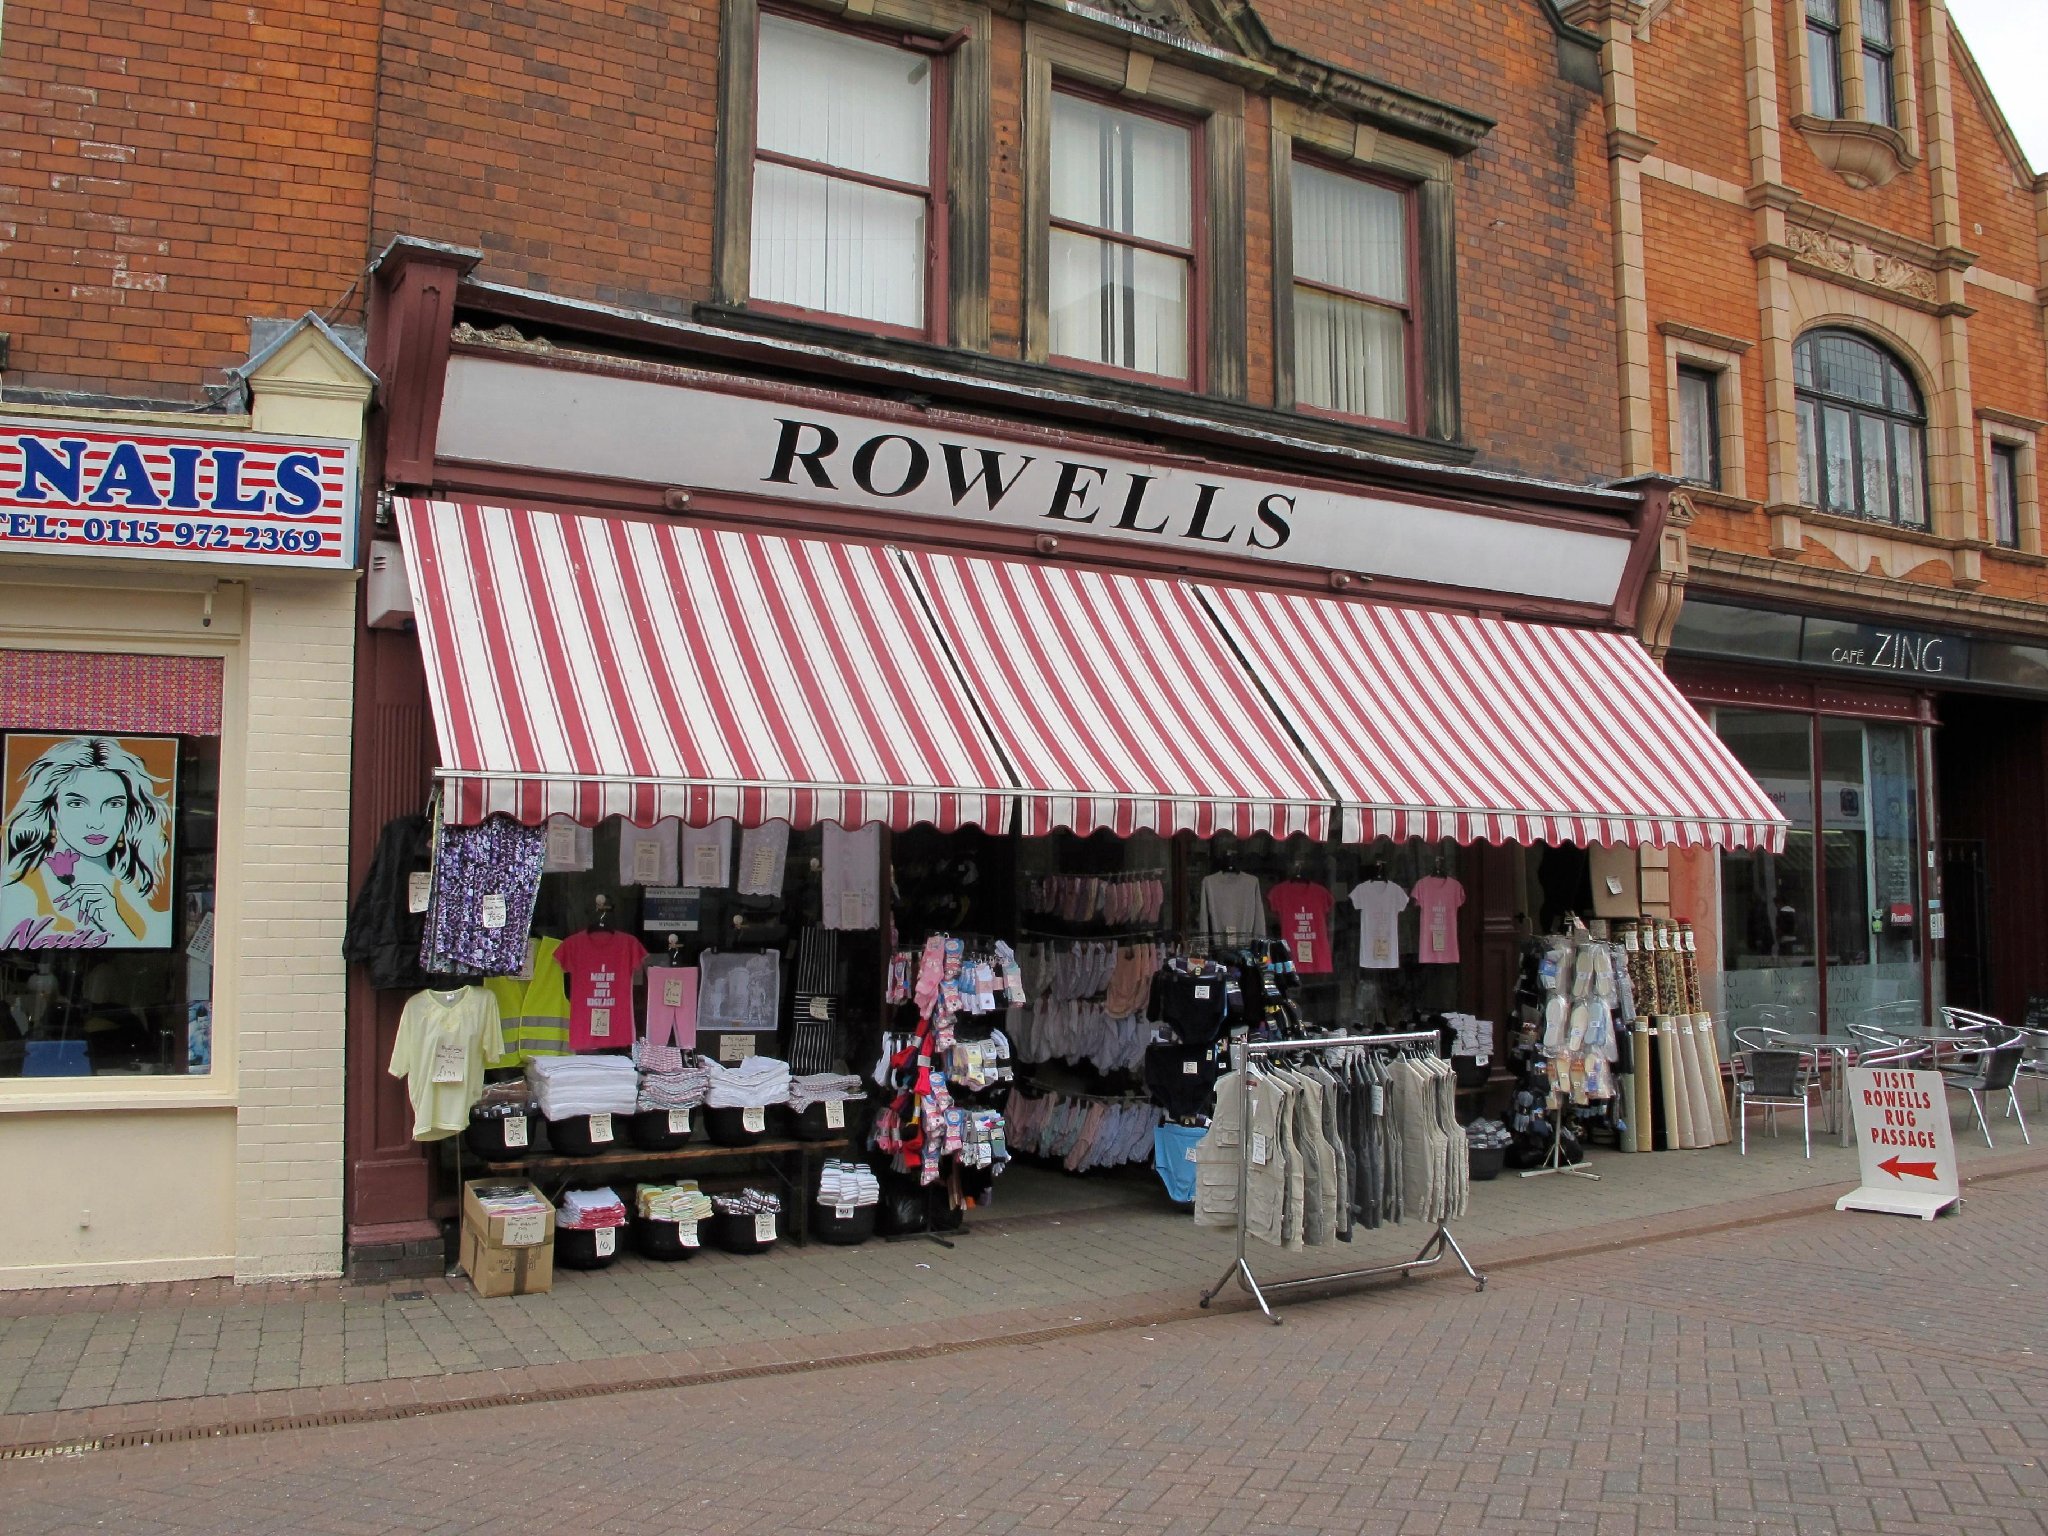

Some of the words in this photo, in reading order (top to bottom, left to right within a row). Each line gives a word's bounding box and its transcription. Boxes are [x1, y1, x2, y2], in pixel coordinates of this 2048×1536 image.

[16, 437, 322, 516] NAILS
[760, 418, 1297, 550] ROWELLS
[84, 518, 160, 545] 0115
[175, 523, 230, 547] 972
[243, 526, 322, 552] 2369
[1872, 632, 1943, 672] ZING
[1872, 1072, 1915, 1089] VISIT
[1863, 1090, 1931, 1109] ROWELLS
[1884, 1109, 1916, 1127] RUG
[1871, 1127, 1936, 1148] PASSAGE
